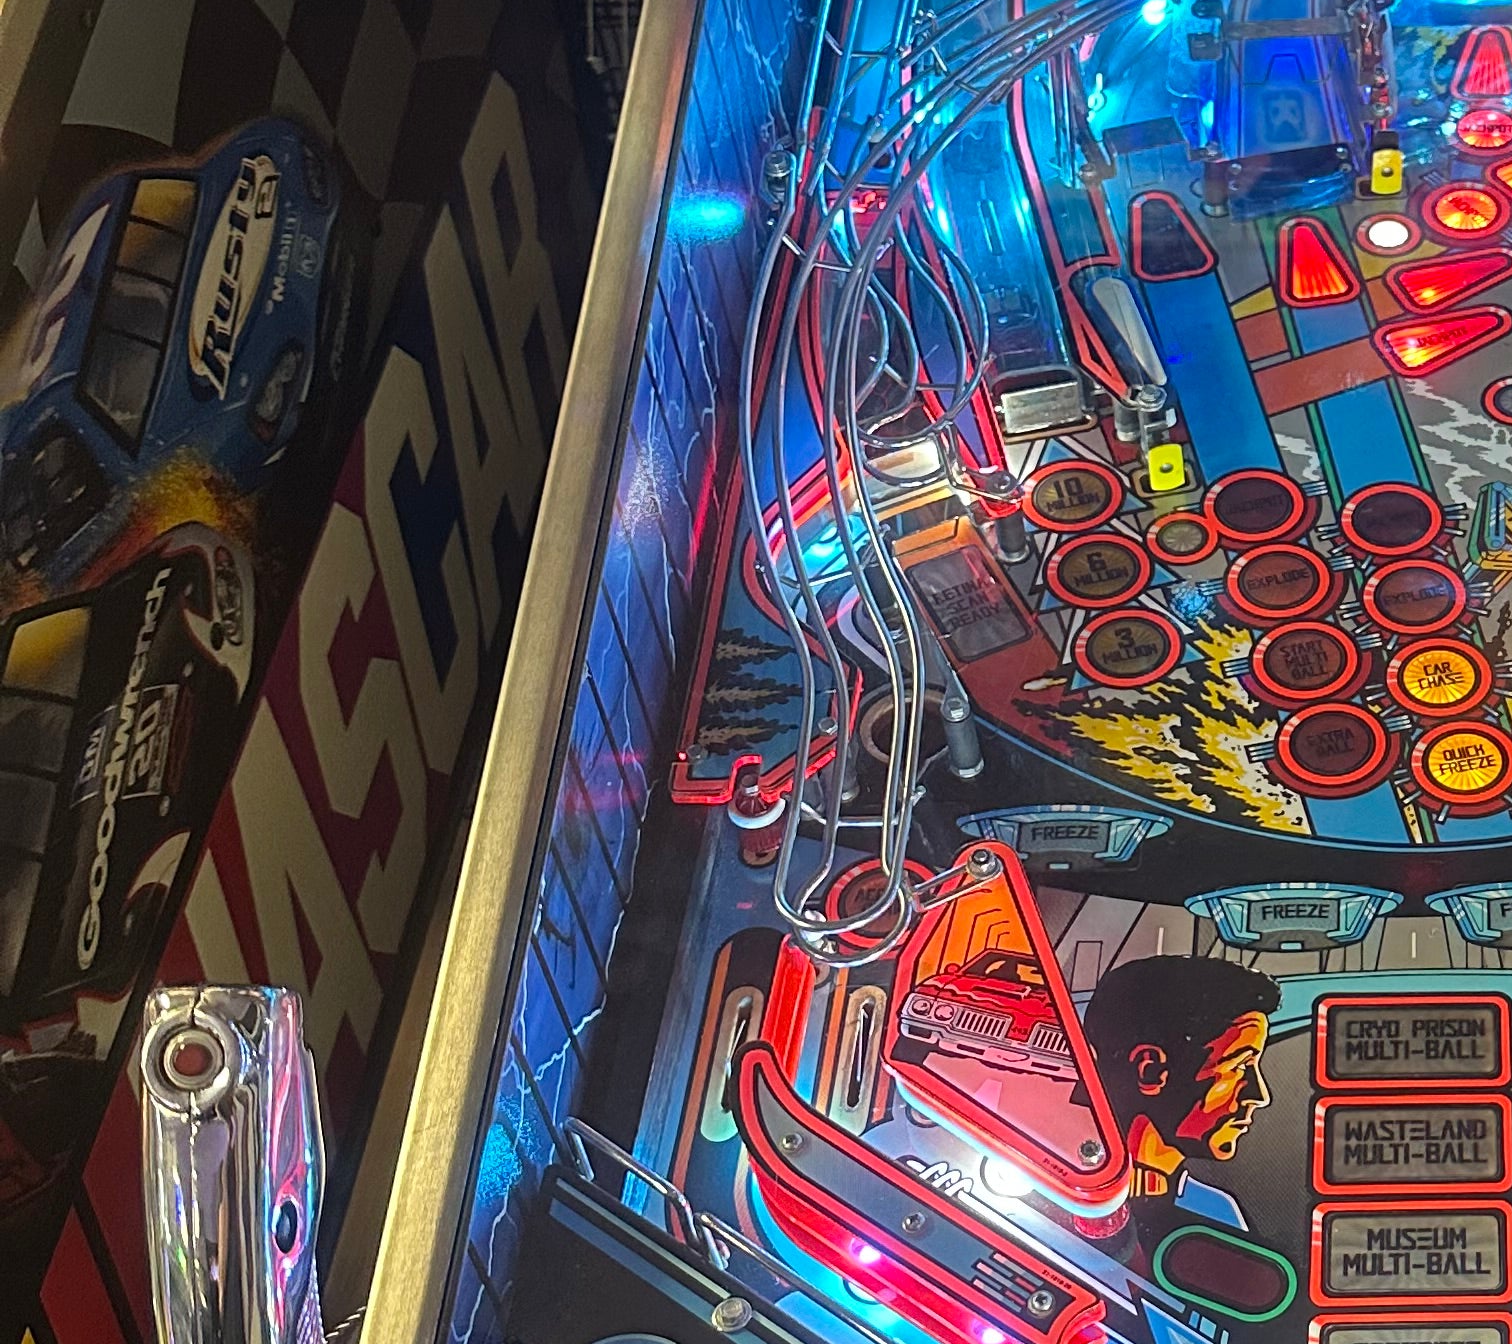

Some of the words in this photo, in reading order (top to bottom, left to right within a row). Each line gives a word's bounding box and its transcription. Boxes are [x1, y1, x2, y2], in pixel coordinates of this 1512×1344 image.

[1053, 476, 1085, 499] 10
[1046, 493, 1101, 513] MILLION
[1087, 551, 1107, 572] 6
[1072, 566, 1130, 587] MILLION
[1247, 567, 1311, 590] EXPLODE
[1114, 627, 1136, 649] 3
[1280, 638, 1324, 656] START
[1101, 642, 1159, 665] MILLION
[1422, 661, 1451, 676] CAR
[1417, 671, 1465, 691] CHASE
[1442, 743, 1486, 762] QUICK
[77, 567, 172, 972] Goodwrench
[1438, 755, 1498, 776] FREEZE
[1030, 823, 1101, 843] FREEZE
[1261, 901, 1330, 922] FREEZE
[1345, 1019, 1400, 1040] CRYO
[1411, 1018, 1487, 1038] PRISON
[1344, 1039, 1486, 1061] MULTI-BALL
[1344, 1119, 1487, 1142] WASTELAND
[1343, 1141, 1488, 1165] MULTI-BALL
[1367, 1227, 1468, 1251] MUSEUM
[1342, 1251, 1491, 1277] MULTI-BALL
